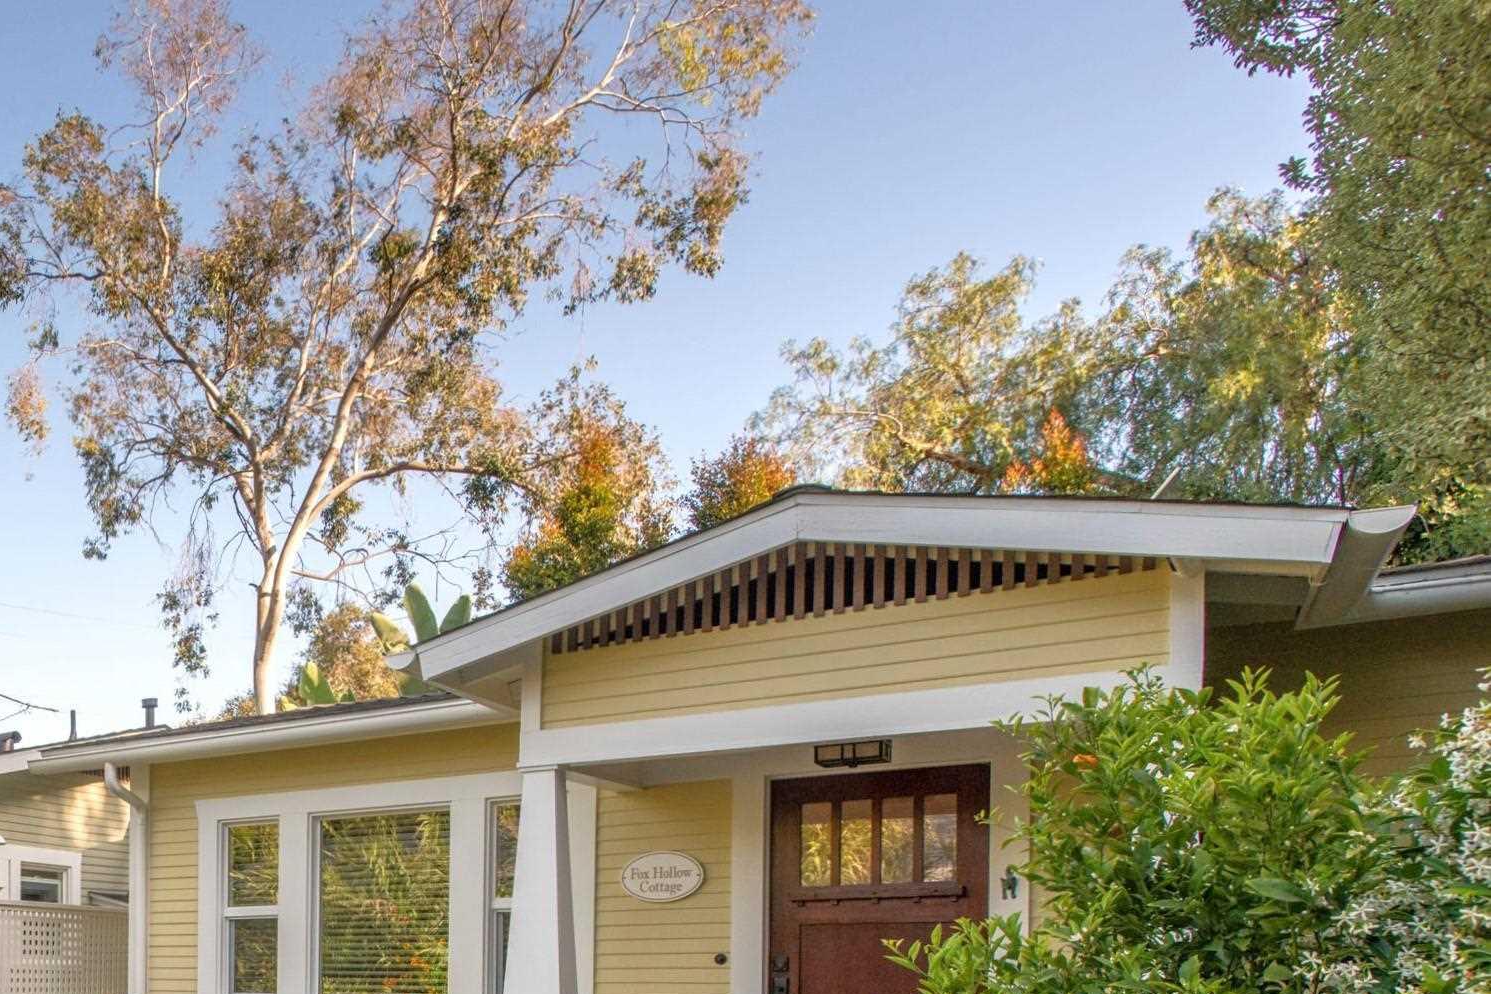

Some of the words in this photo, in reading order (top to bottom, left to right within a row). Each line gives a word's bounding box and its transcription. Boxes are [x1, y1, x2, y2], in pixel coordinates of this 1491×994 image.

[631, 867, 650, 880] Fox
[653, 865, 692, 879] Hollow
[639, 881, 683, 895] Cottage
